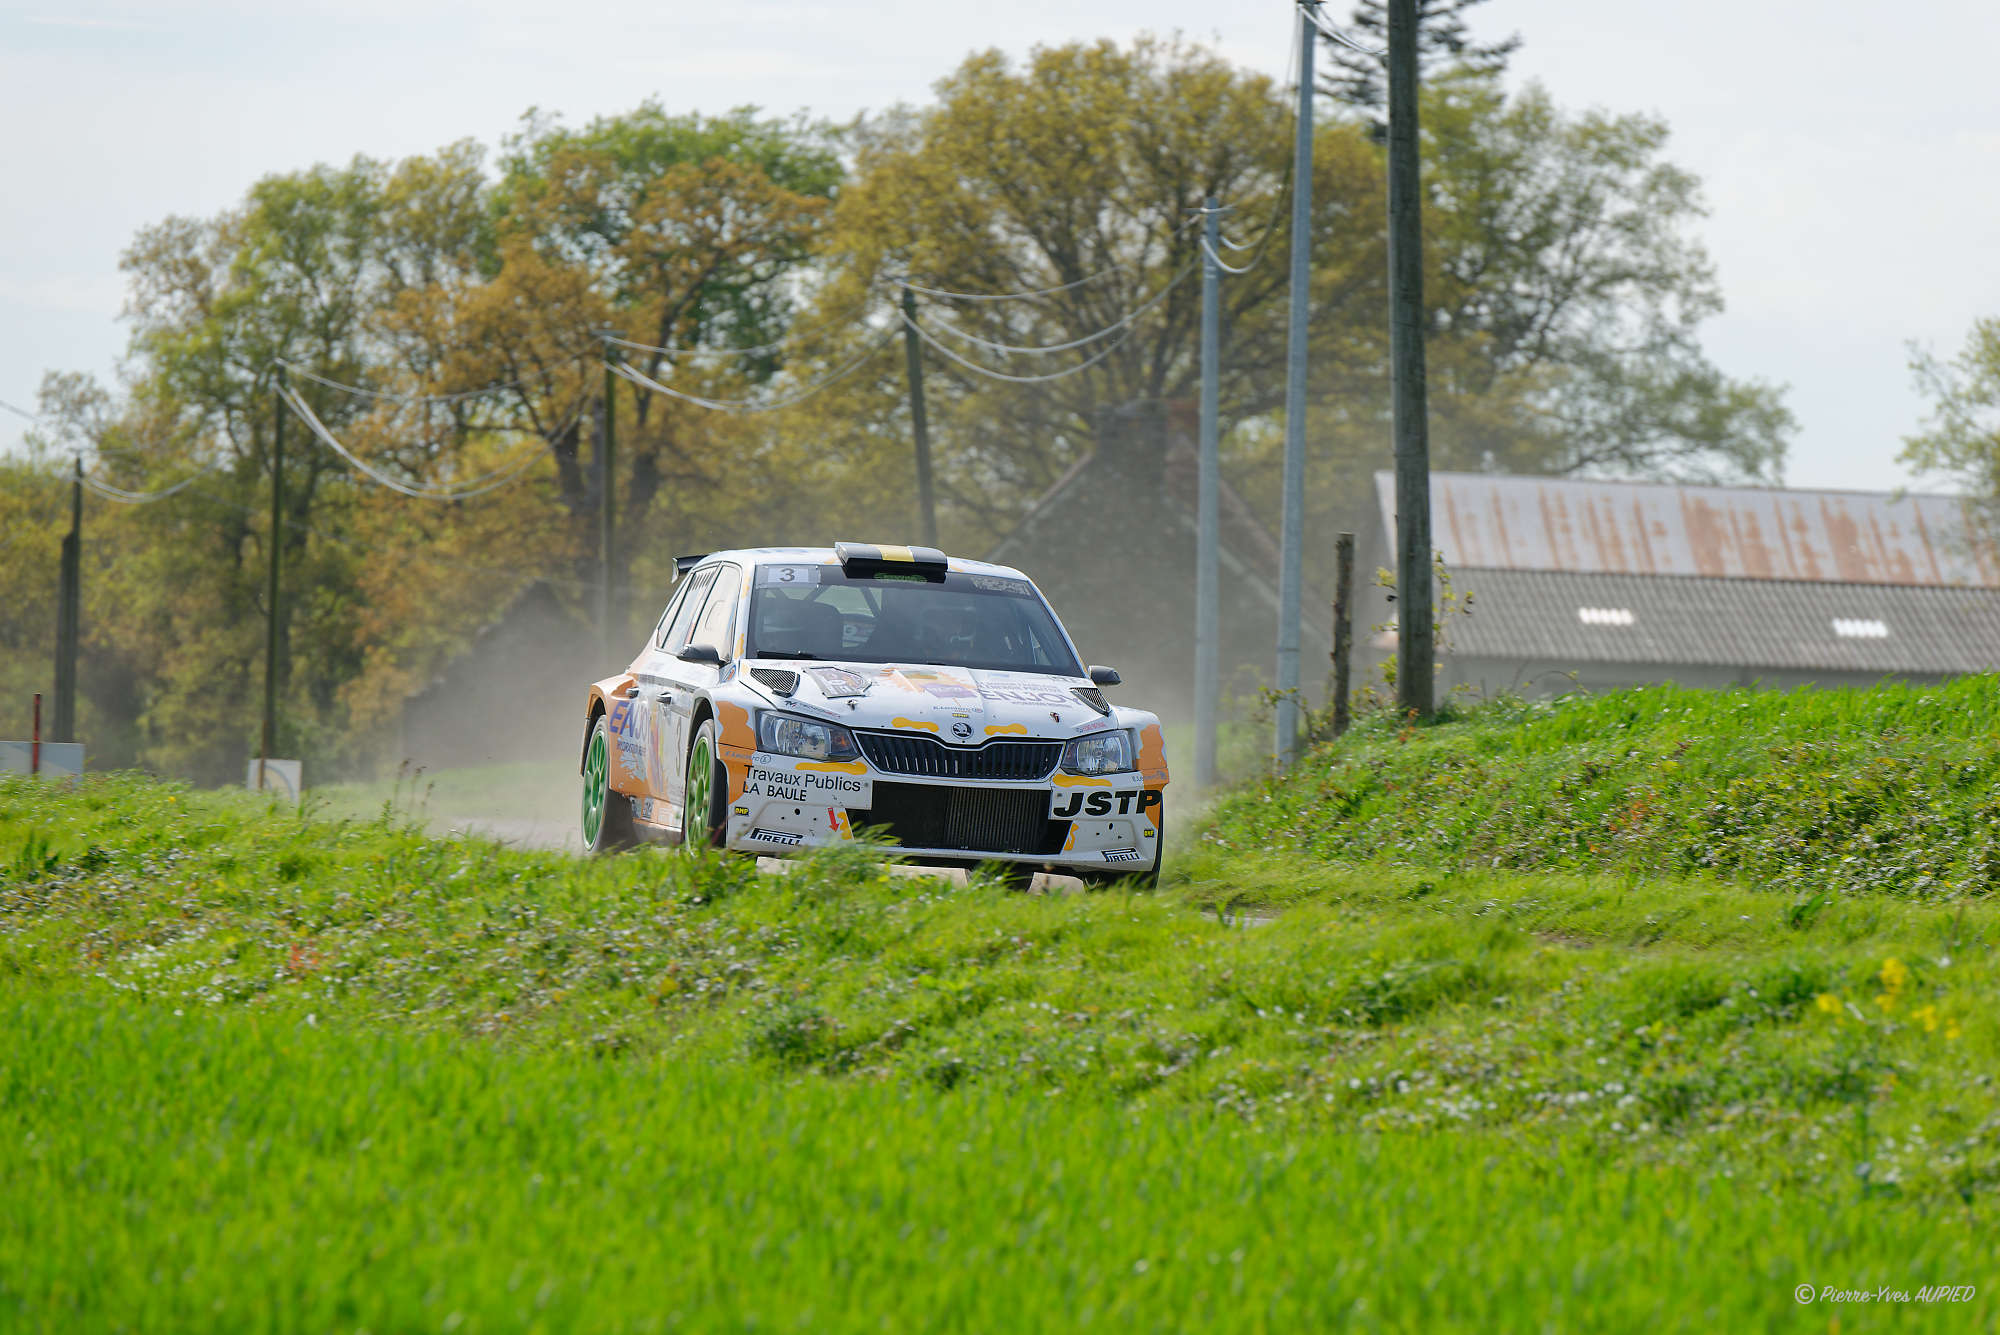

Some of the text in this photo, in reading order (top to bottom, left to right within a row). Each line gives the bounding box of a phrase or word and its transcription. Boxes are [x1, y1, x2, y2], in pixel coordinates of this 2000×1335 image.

[779, 568, 796, 582] 3
[744, 765, 861, 792] Travaux Publics
[743, 781, 807, 801] LA BAULE
[1053, 790, 1161, 817] JSTP
[750, 828, 804, 846] PIRELLI
[1101, 847, 1140, 863] PIRELLI
